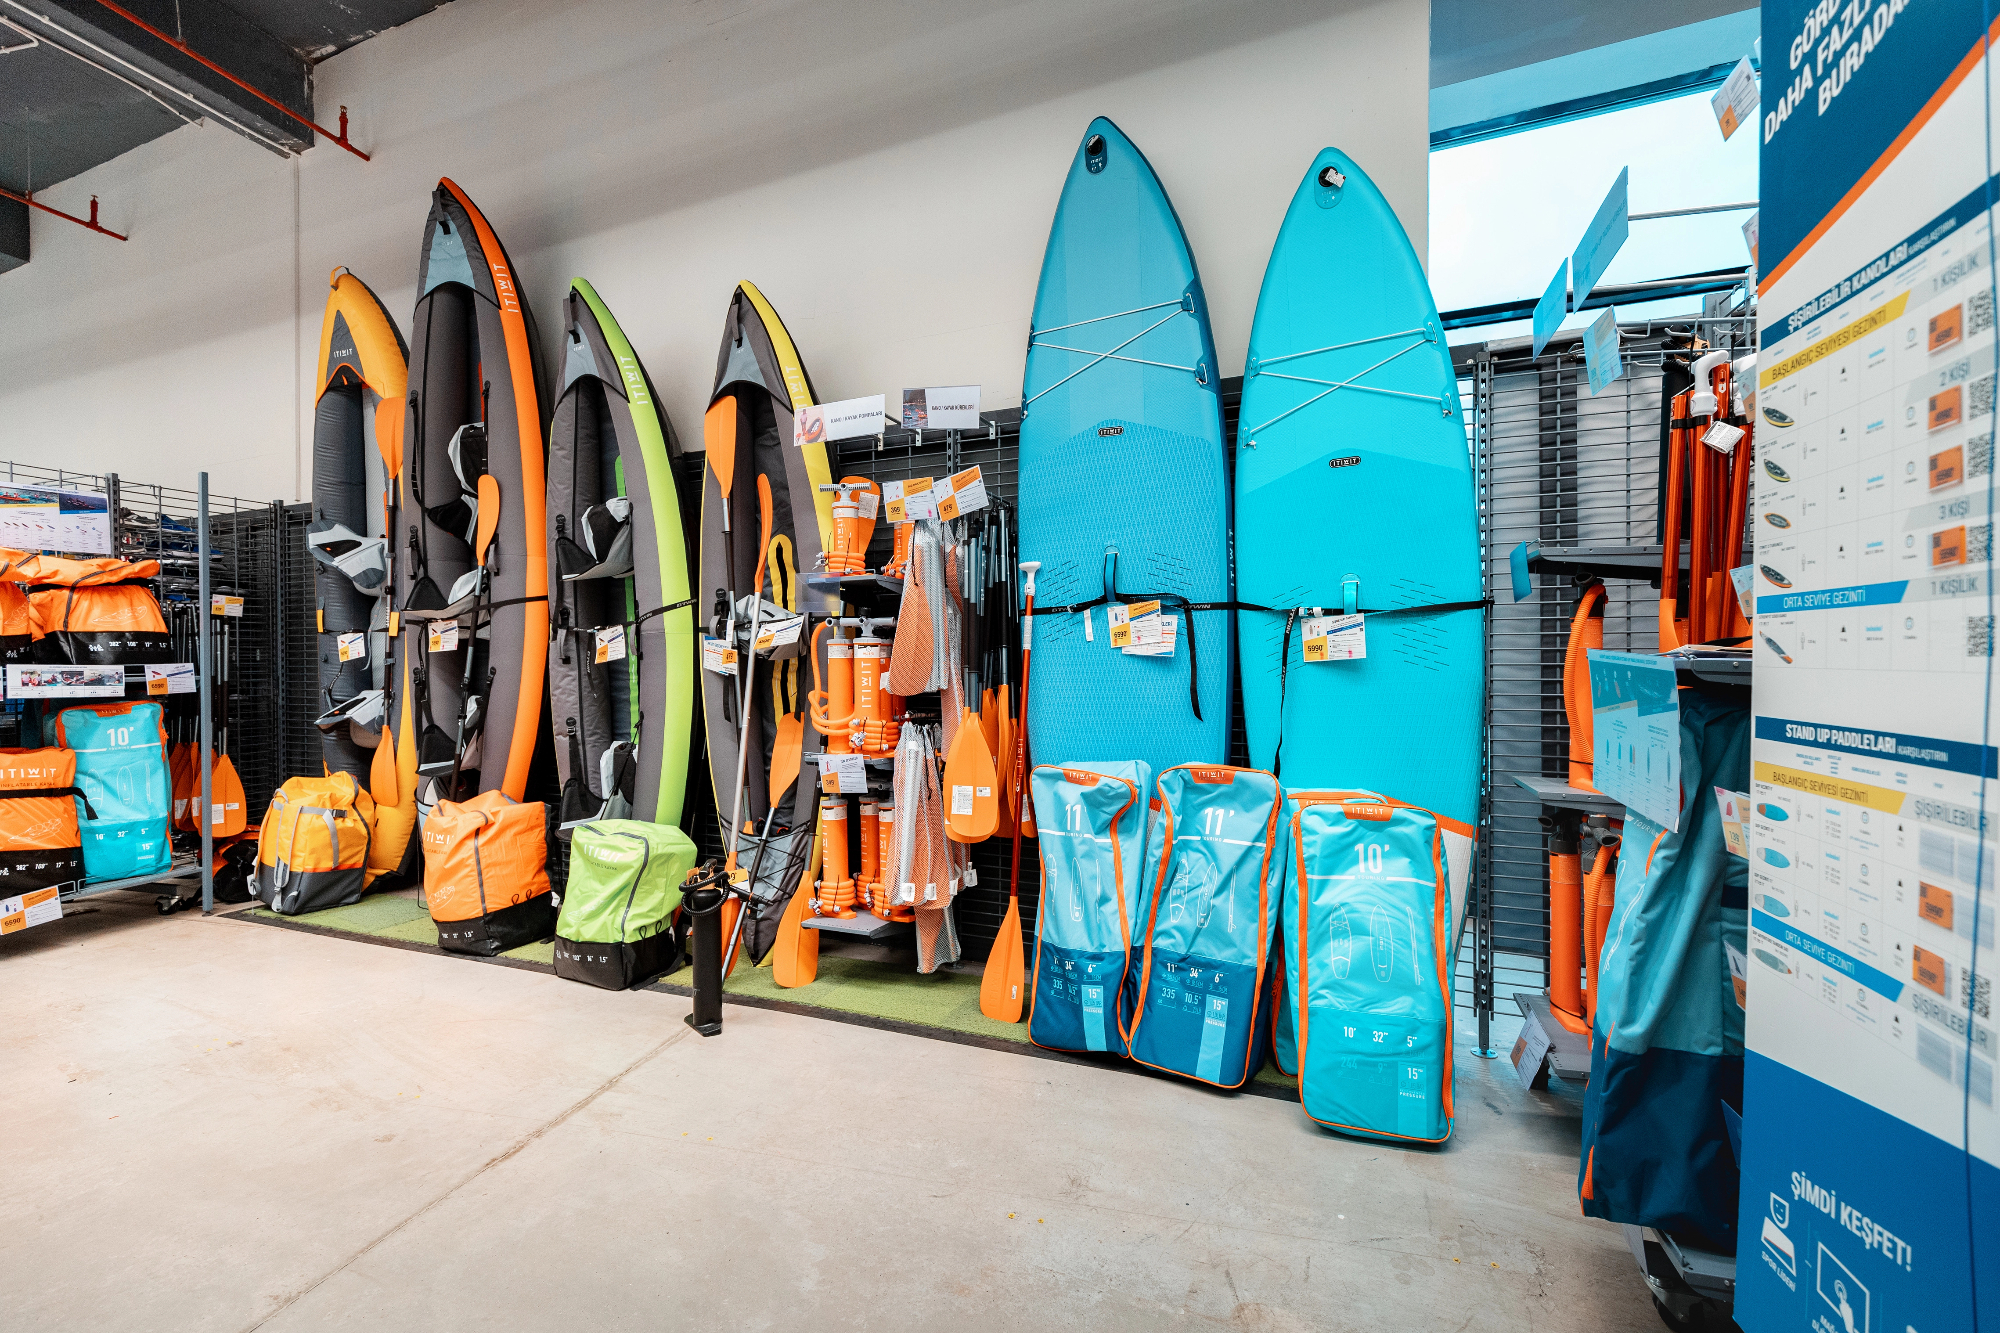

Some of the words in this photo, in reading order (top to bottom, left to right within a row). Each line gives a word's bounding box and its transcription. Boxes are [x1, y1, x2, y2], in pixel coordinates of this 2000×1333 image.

[1764, 63, 1813, 145] DAHA
[1817, 0, 1872, 77] FAZL
[493, 263, 519, 313] ITIWIT
[333, 348, 353, 358] ITIWIT
[1772, 350, 1814, 381] BAŞLANGIÇ
[1815, 331, 1849, 359] SEVİYESİ
[1851, 305, 1887, 338] GEZİNTİ
[620, 355, 648, 405] ITIWIT
[785, 365, 807, 409] TIWIT
[1783, 596, 1802, 609] ORTA
[1804, 591, 1831, 607] SEVİYE
[1833, 586, 1866, 604] GEZİNTİ
[861, 660, 872, 708] ITIWIT
[1785, 724, 1815, 741] STAND
[1817, 728, 1831, 743] UP
[0, 768, 57, 779] ITIWIT
[1069, 772, 1093, 781] ITIWIT
[1773, 771, 1808, 792] BAŞLANGIÇ
[1809, 777, 1839, 796] SEVİYESİ
[1840, 785, 1869, 804] GEZİNTİ
[1352, 807, 1384, 815] ITIWIT
[1914, 798, 1990, 834] ŞİŞİRİLEBİLR
[584, 844, 623, 862] ITIWIT
[1785, 930, 1802, 947] ORTA
[1802, 938, 1826, 960] SEVİYE
[1827, 952, 1855, 975] GEZİNTİ
[1161, 988, 1176, 999] 335
[1399, 1091, 1425, 1100] PRESSURE
[1790, 1171, 1836, 1220] ŞİMDİ
[1840, 1201, 1912, 1273] KEŞFET!
[1761, 1250, 1777, 1270] SPOR
